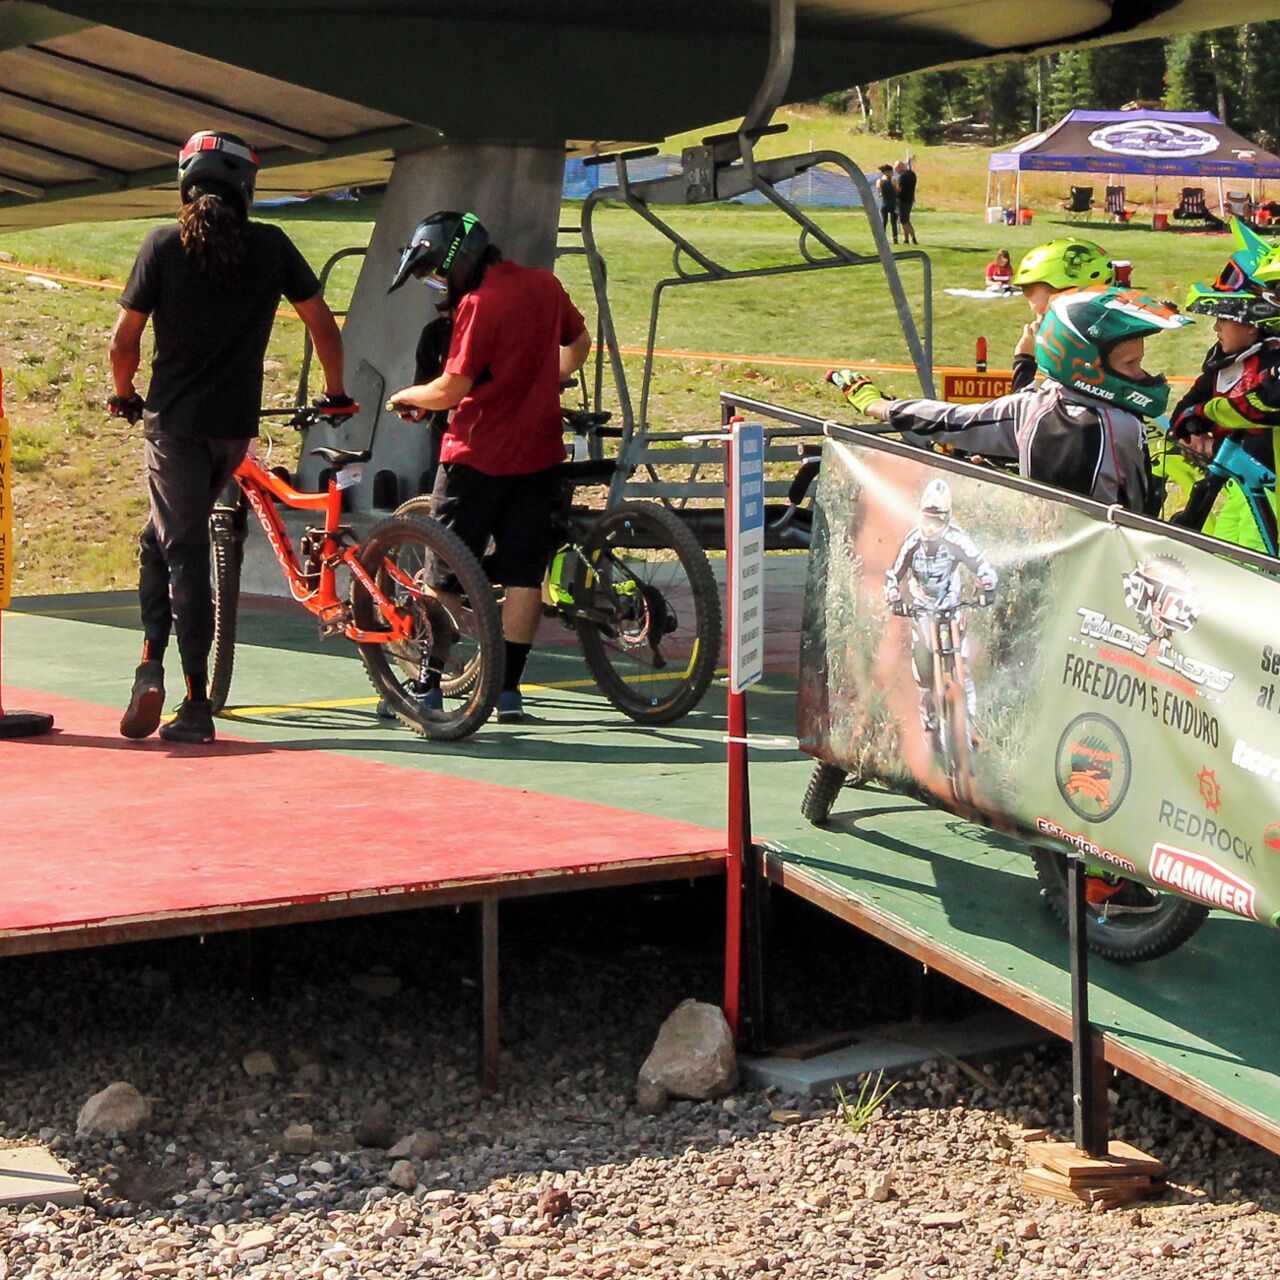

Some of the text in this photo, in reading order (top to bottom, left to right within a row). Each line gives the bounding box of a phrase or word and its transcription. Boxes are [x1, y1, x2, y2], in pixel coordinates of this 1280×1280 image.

[442, 236, 461, 270] SMITH
[953, 379, 1013, 397] NOTICE
[1073, 379, 1154, 408] MAXXIS FOX
[247, 489, 290, 572] KNOLLY
[1076, 606, 1152, 657] RACERS
[1062, 653, 1147, 712] FREEDOM
[1151, 684, 1159, 718] 5
[1163, 690, 1220, 748] ENDURO
[1256, 684, 1276, 710] at
[1158, 798, 1256, 868] REDROCK
[1152, 852, 1251, 917] HAMMER
